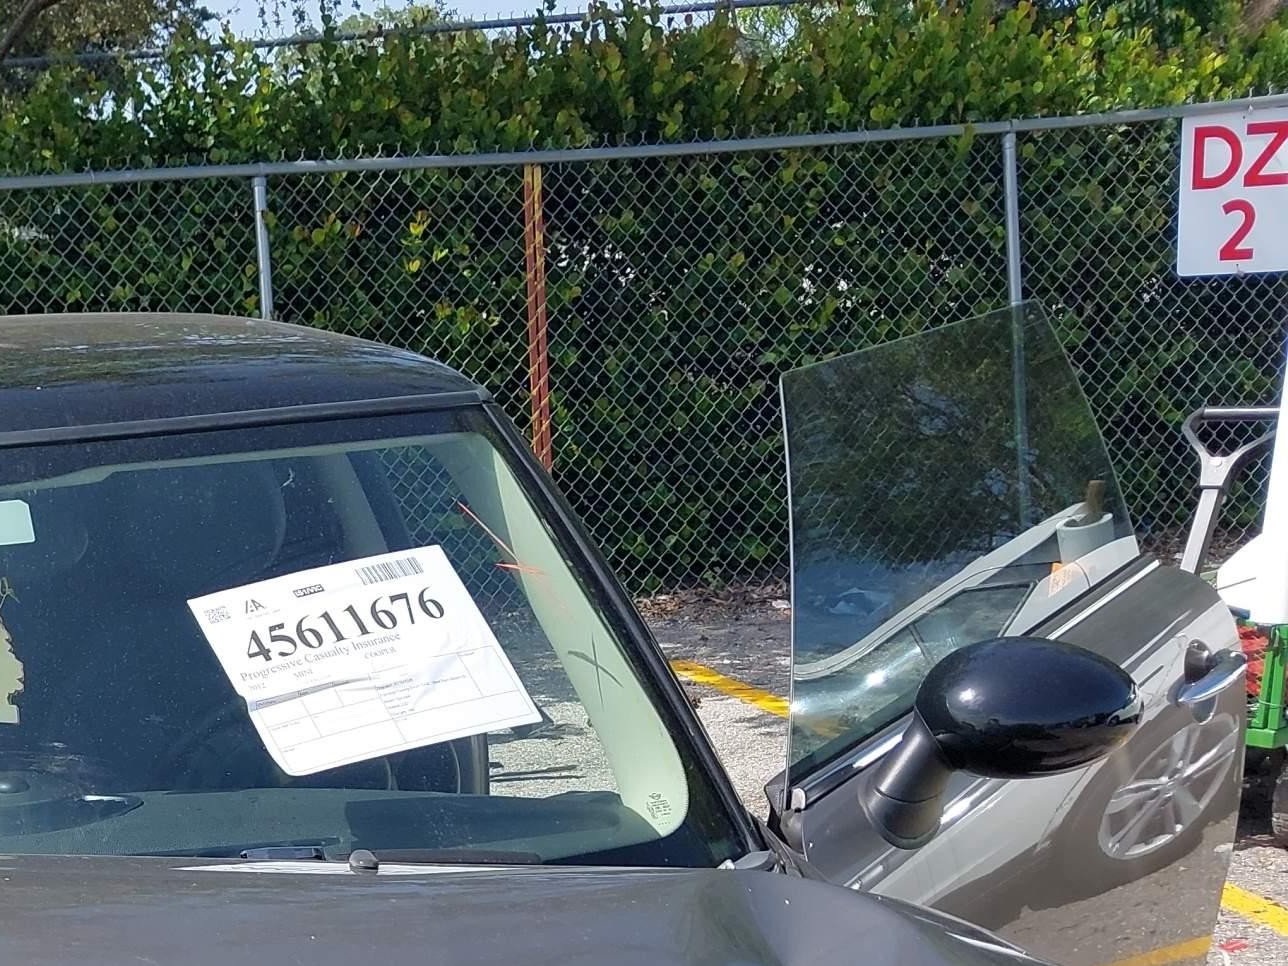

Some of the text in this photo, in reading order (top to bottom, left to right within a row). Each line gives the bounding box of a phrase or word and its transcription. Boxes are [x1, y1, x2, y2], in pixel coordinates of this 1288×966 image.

[1192, 120, 1288, 190] DZ
[1219, 198, 1256, 261] 2
[246, 586, 445, 662] 45611676
[240, 633, 402, 682] Progressive Casualty Insurance
